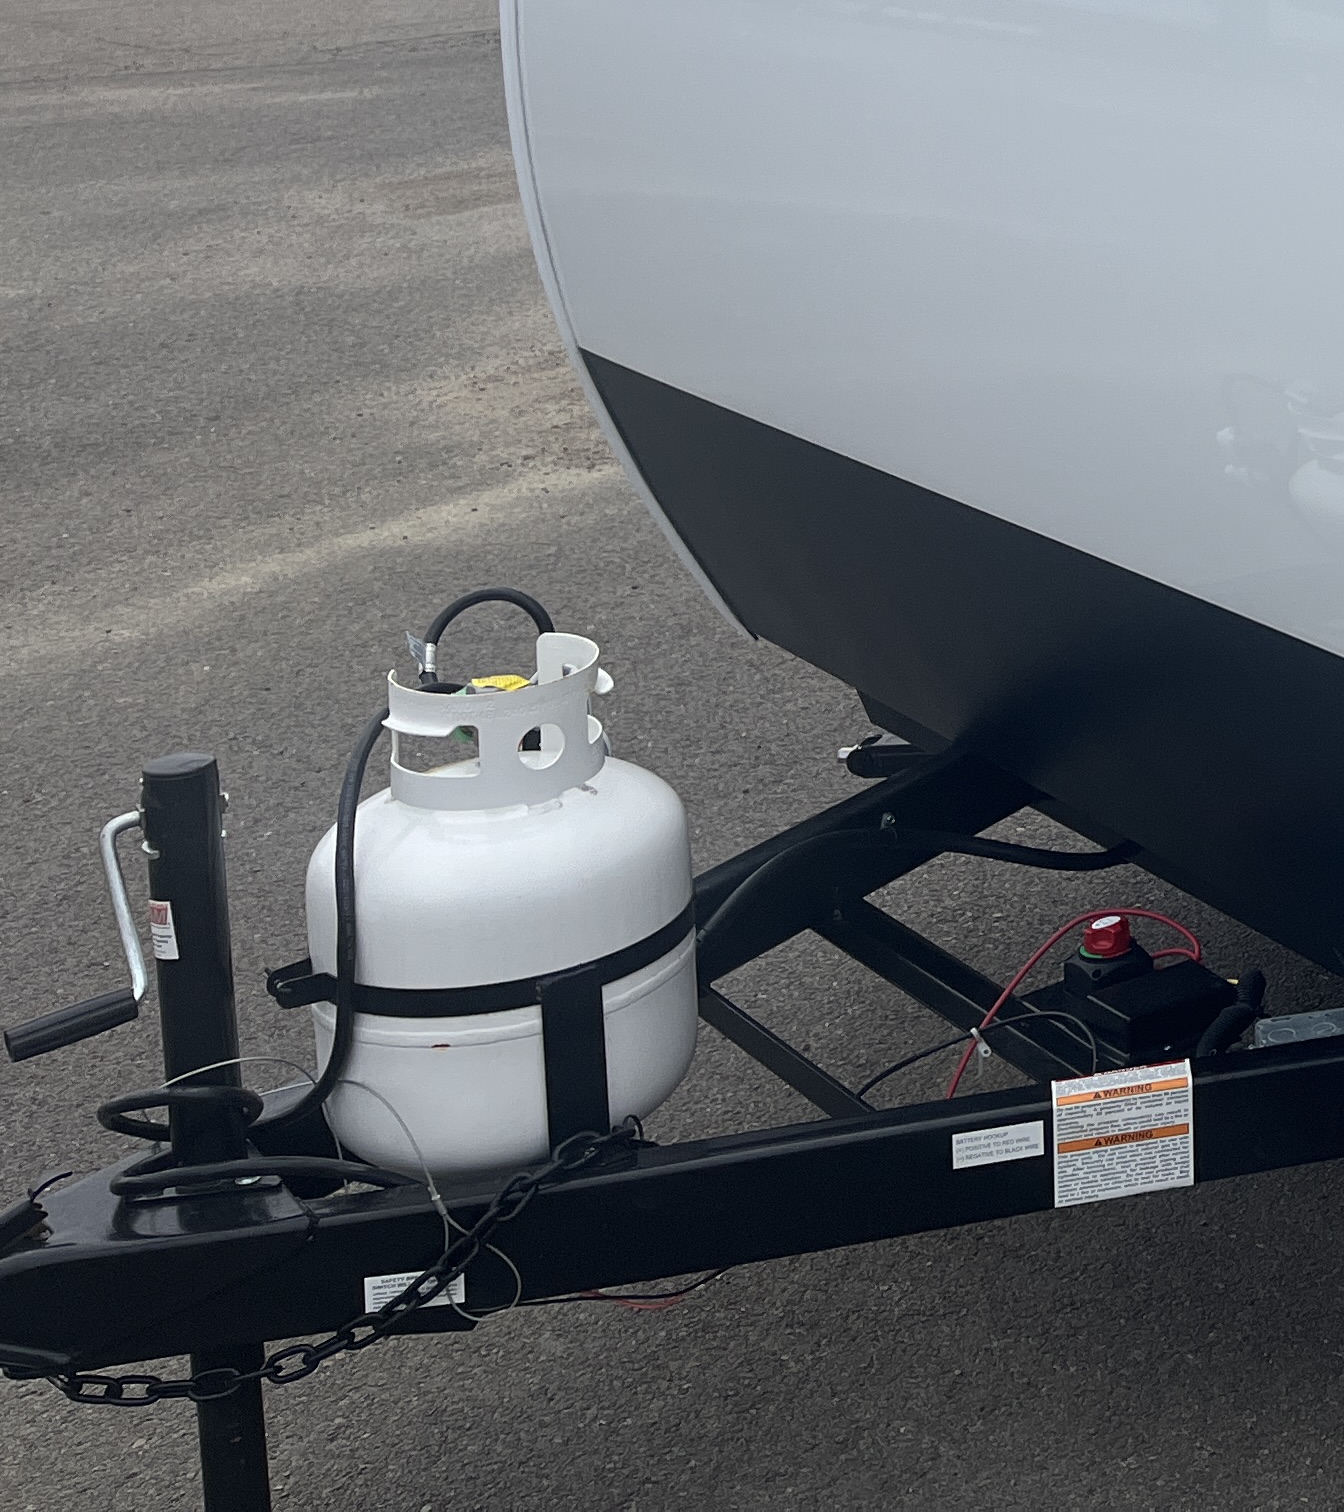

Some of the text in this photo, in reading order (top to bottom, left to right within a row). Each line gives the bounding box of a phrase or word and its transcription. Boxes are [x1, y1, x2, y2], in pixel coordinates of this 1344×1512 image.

[1103, 1083, 1152, 1098] WARNING
[955, 1136, 982, 1146] BATTERY
[1104, 1130, 1153, 1144] WARNING
